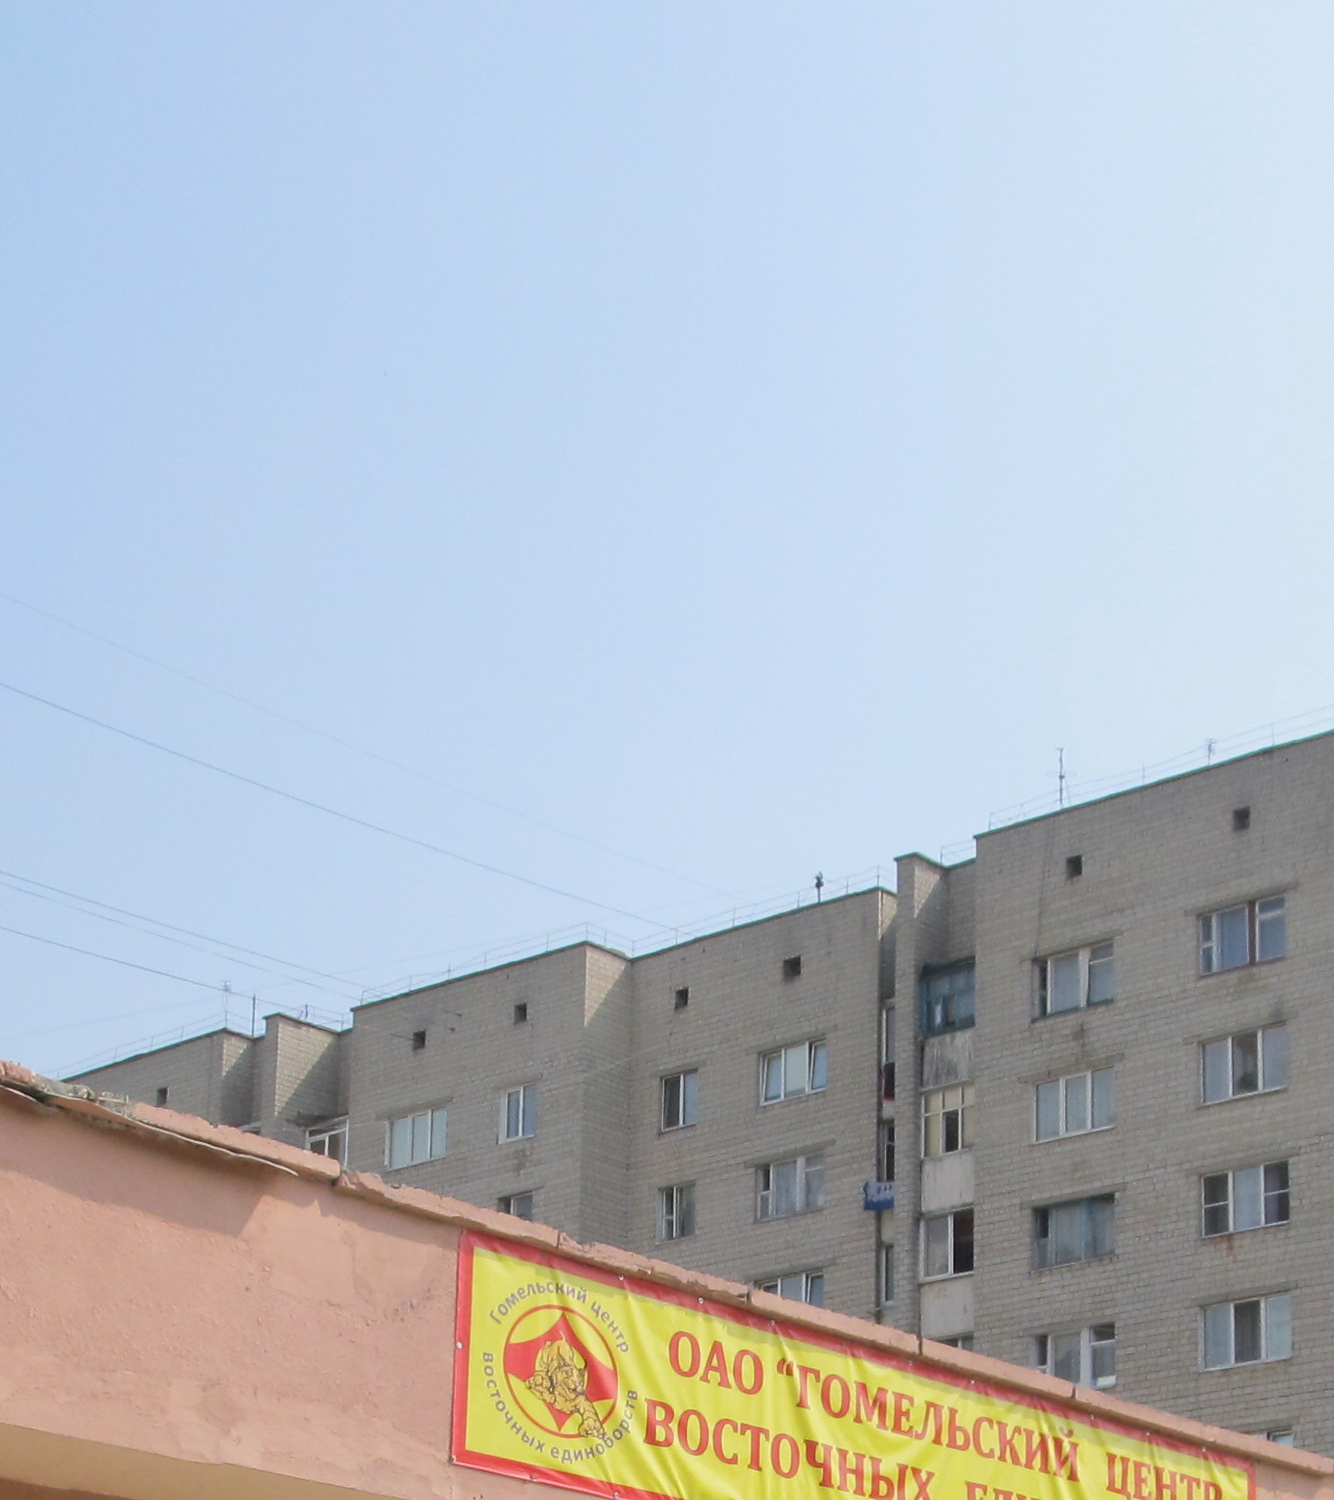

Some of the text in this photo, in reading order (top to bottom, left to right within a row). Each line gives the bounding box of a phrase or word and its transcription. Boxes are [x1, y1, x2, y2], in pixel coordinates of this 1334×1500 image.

[489, 1281, 630, 1353] Гомельский центр
[668, 1331, 765, 1395] ОАО
[482, 1351, 545, 1453] восточных
